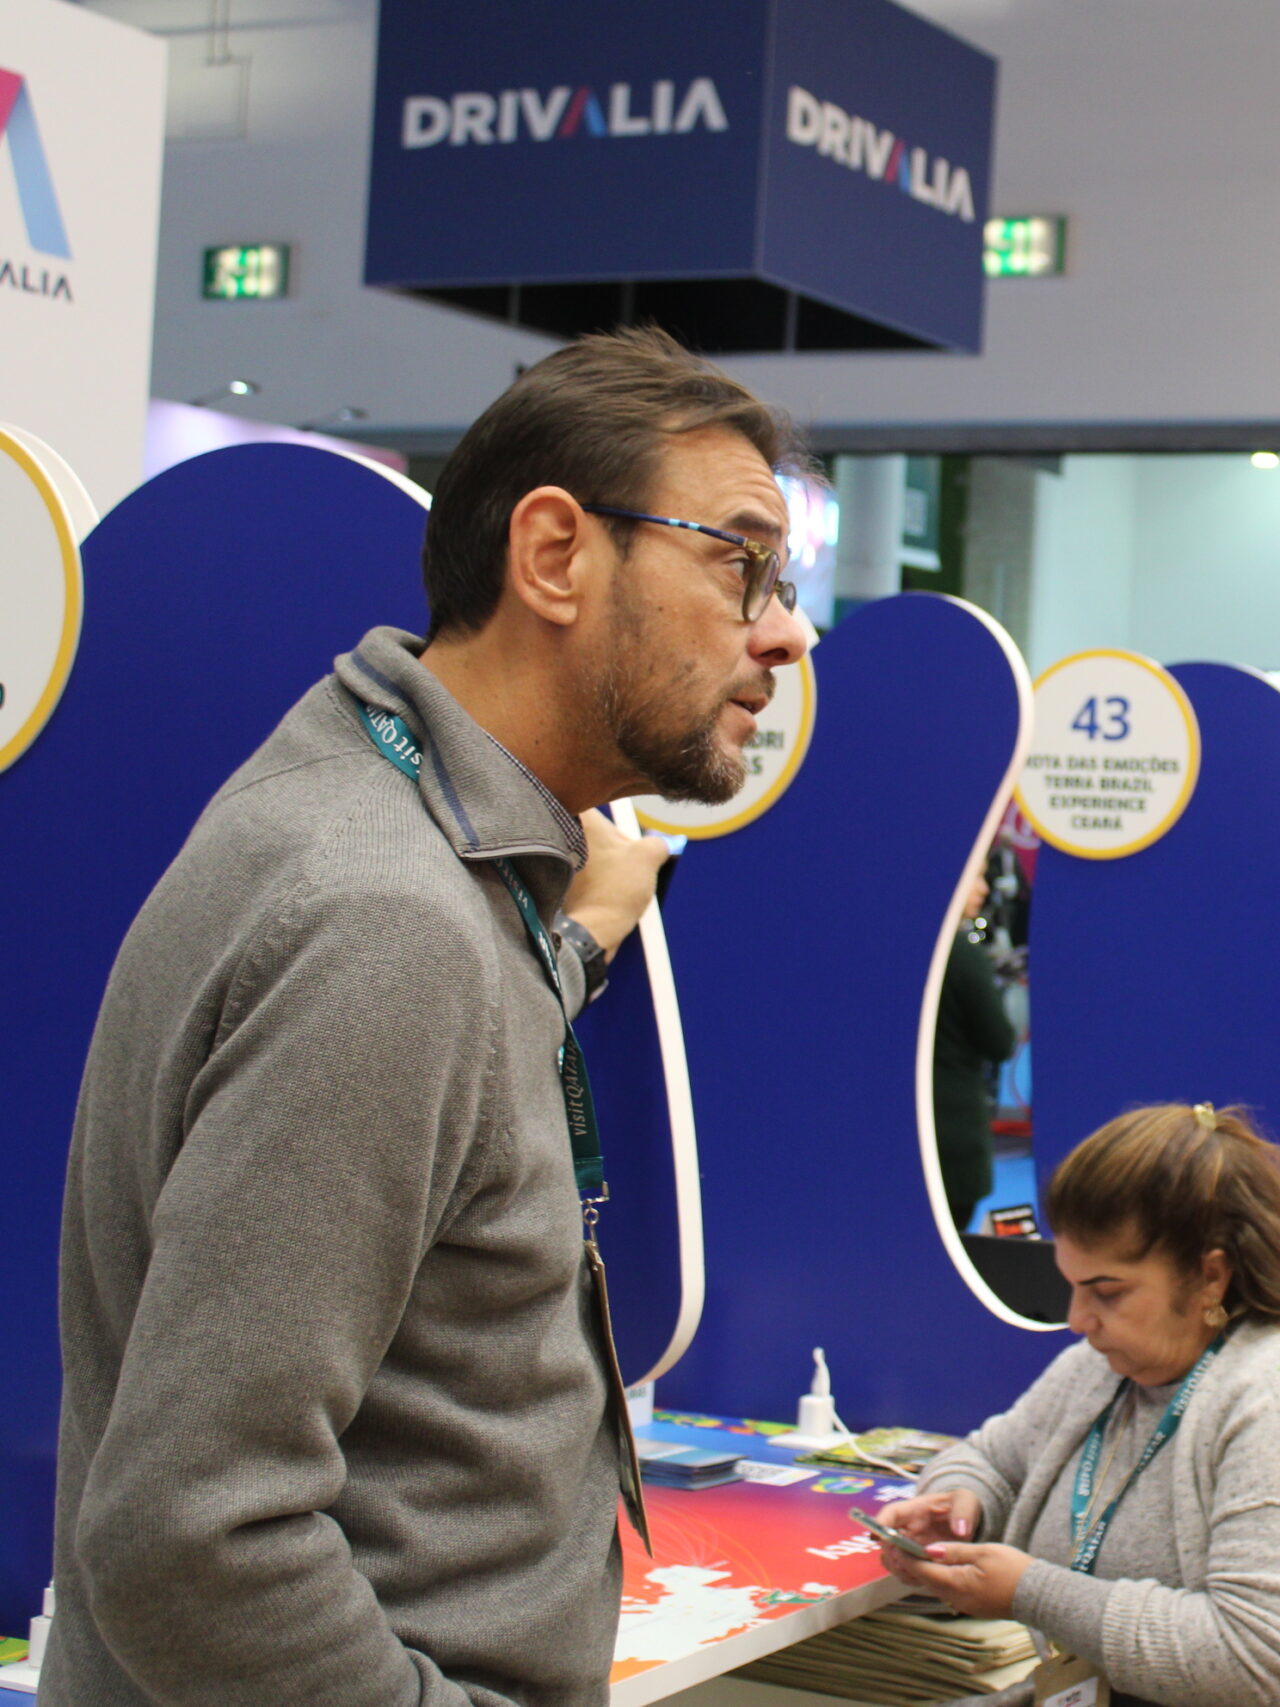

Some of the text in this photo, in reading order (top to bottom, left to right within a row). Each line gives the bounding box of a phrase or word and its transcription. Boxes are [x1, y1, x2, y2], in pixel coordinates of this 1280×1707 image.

[403, 77, 729, 149] DRIVALIA
[787, 86, 975, 222] DRIVALIA
[1072, 697, 1130, 741] 43
[1067, 757, 1097, 770] DAS
[1046, 775, 1153, 792] TERRA BRAZIL
[1050, 795, 1147, 812] EXPERIENCE
